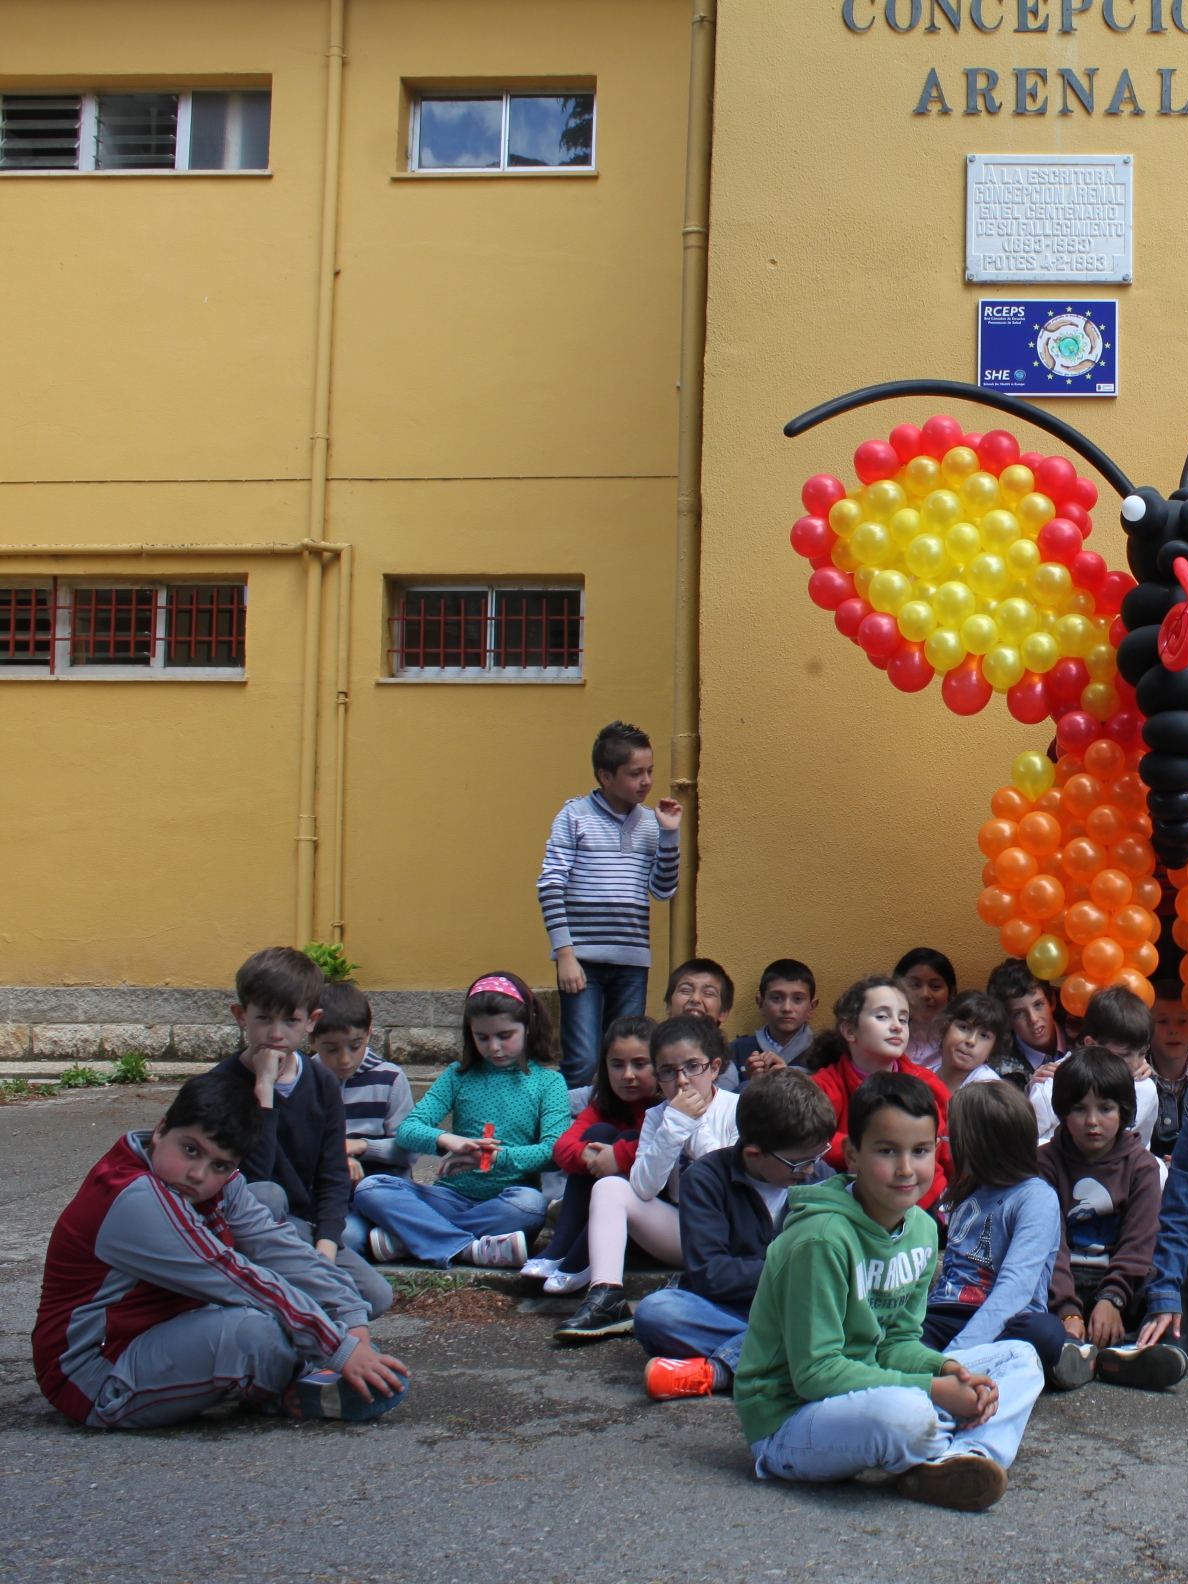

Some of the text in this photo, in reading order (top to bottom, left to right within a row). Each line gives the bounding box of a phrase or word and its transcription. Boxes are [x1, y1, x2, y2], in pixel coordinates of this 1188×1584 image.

[983, 165, 1115, 185] A LA ESCRITORA
[974, 185, 1125, 205] CONCEPCION ARENAL
[979, 205, 1118, 220] EN EL CENTENARIO
[976, 220, 1125, 236] DE SU FALLECIMIENTO
[982, 254, 1036, 270] POTES
[984, 306, 1025, 317] RCEPS
[984, 370, 1010, 380] SHE
